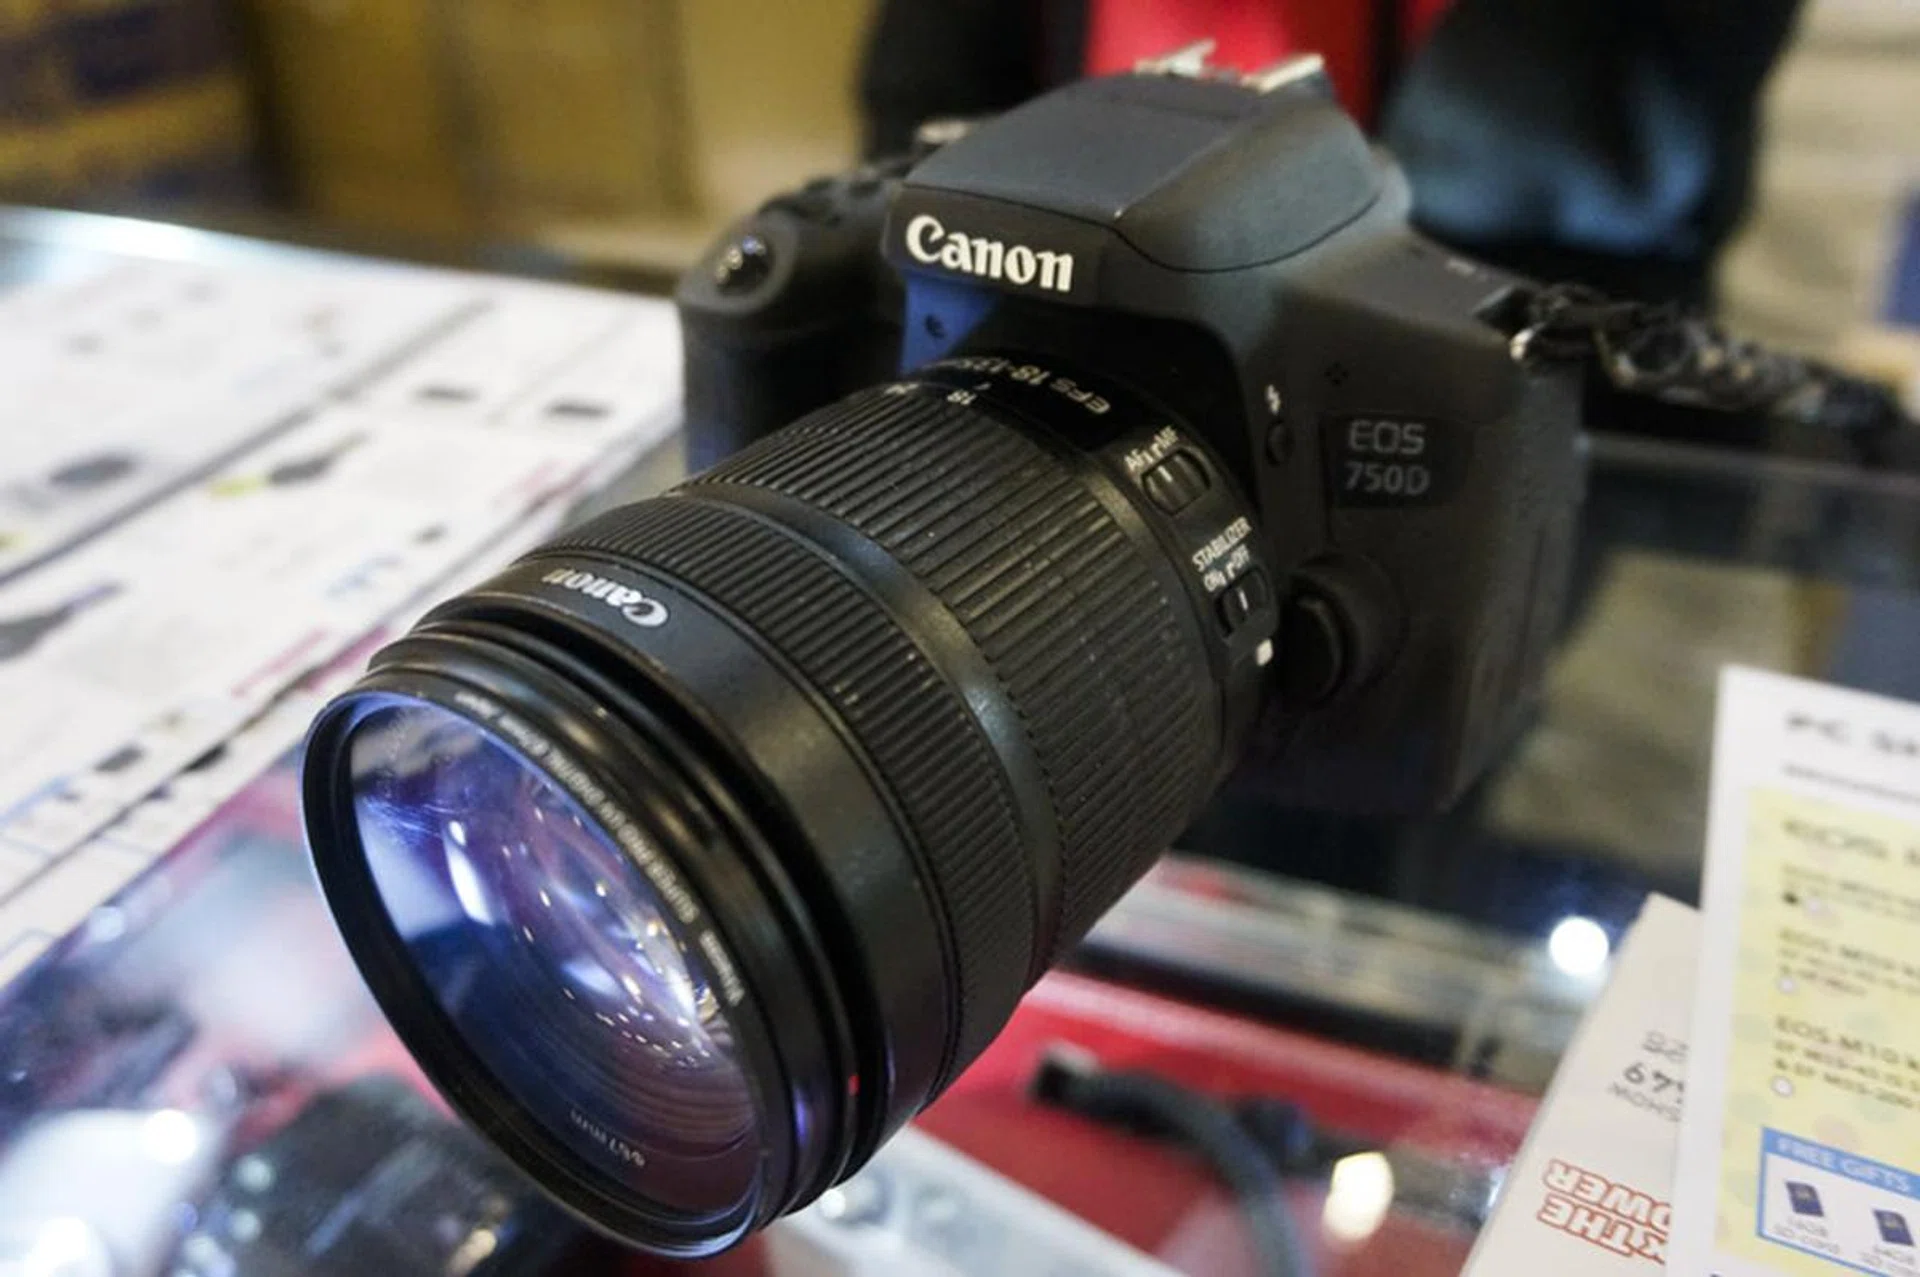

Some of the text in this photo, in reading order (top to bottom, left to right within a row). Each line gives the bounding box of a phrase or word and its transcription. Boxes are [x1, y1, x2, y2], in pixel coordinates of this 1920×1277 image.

[906, 214, 1074, 292] Canon
[1349, 418, 1426, 455] EOS
[1345, 460, 1432, 496] 750D
[1192, 516, 1252, 572] STABILIZER
[541, 567, 669, 628] Canon
[1537, 1192, 1633, 1258] THE
